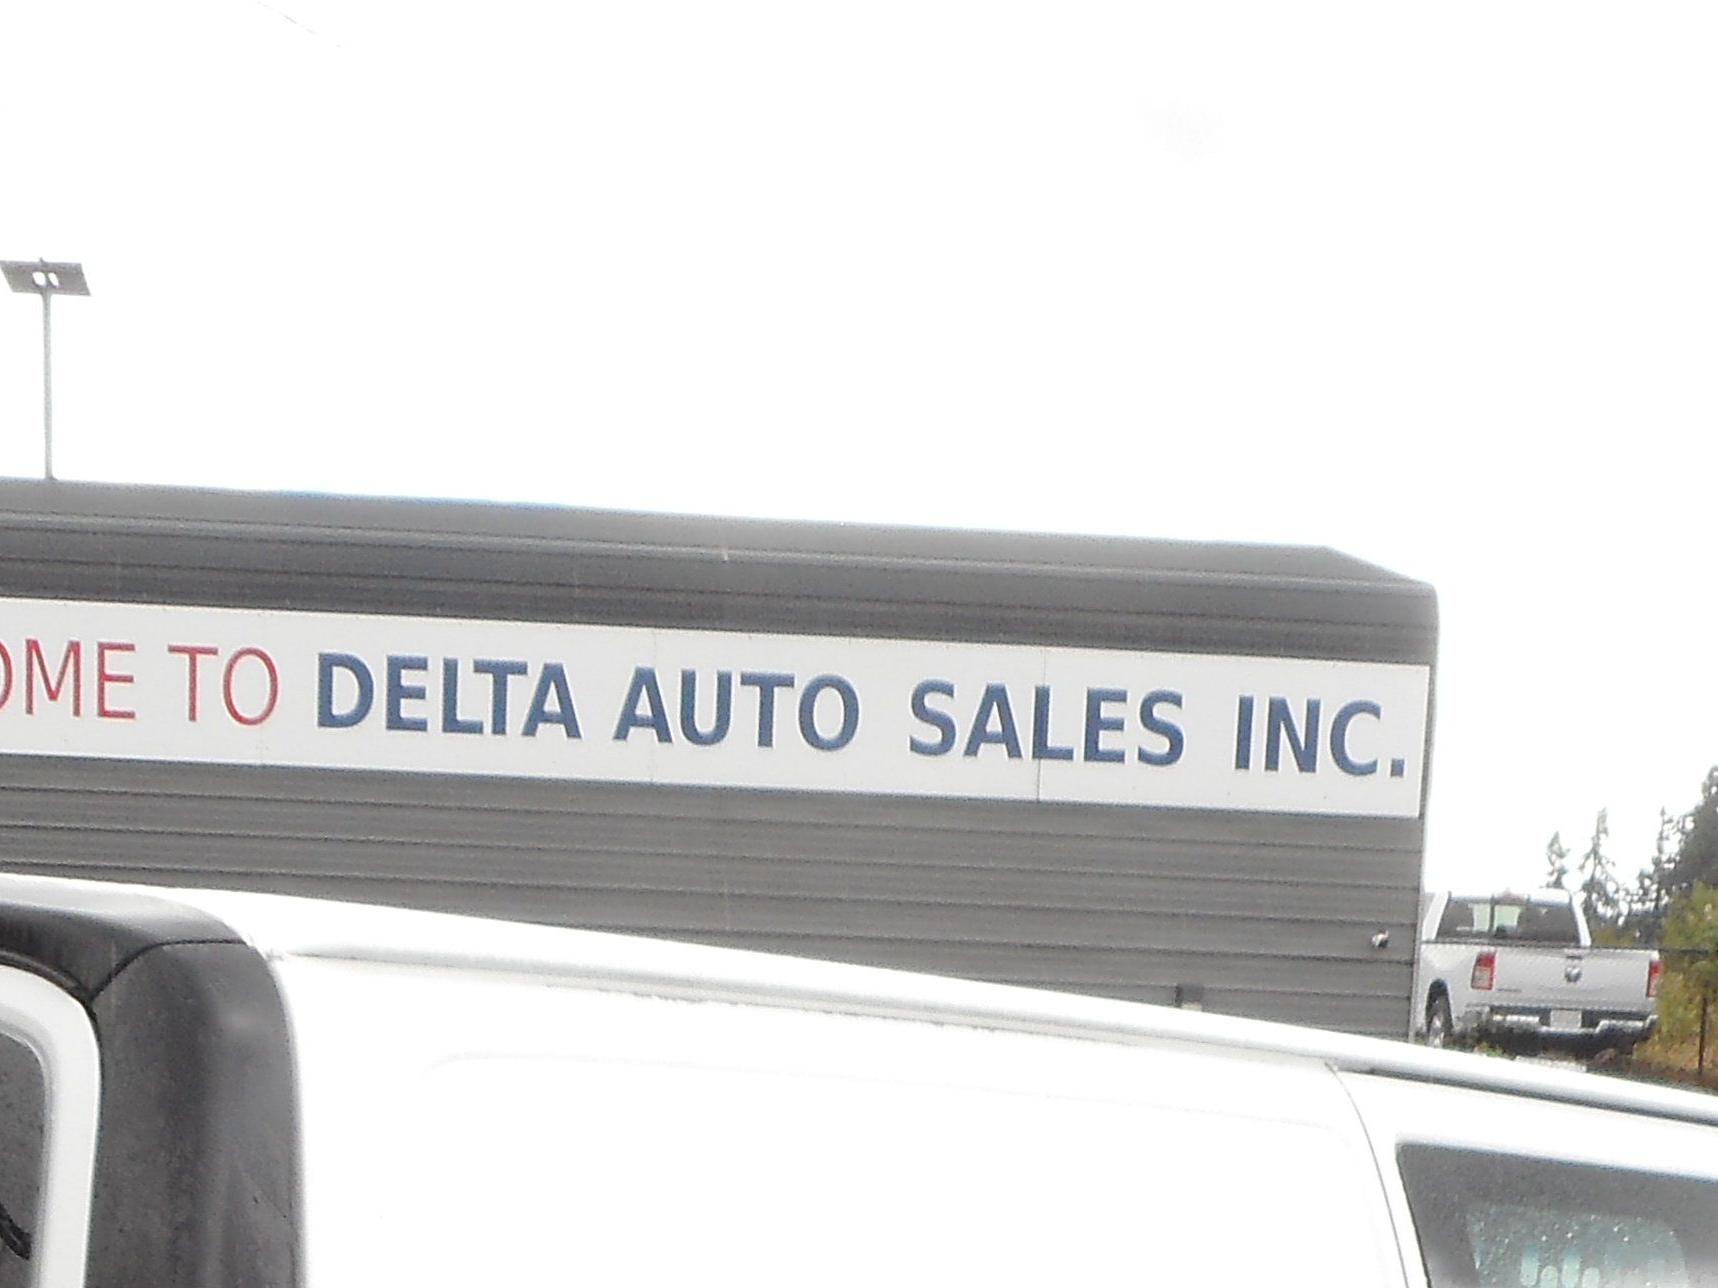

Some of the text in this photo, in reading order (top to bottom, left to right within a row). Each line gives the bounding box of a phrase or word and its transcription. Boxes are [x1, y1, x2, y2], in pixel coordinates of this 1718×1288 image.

[167, 645, 279, 726] TO
[316, 651, 582, 739] DELTA
[612, 666, 860, 751] AUTO
[908, 678, 1185, 766] SALES
[1234, 694, 1406, 778] INC.
